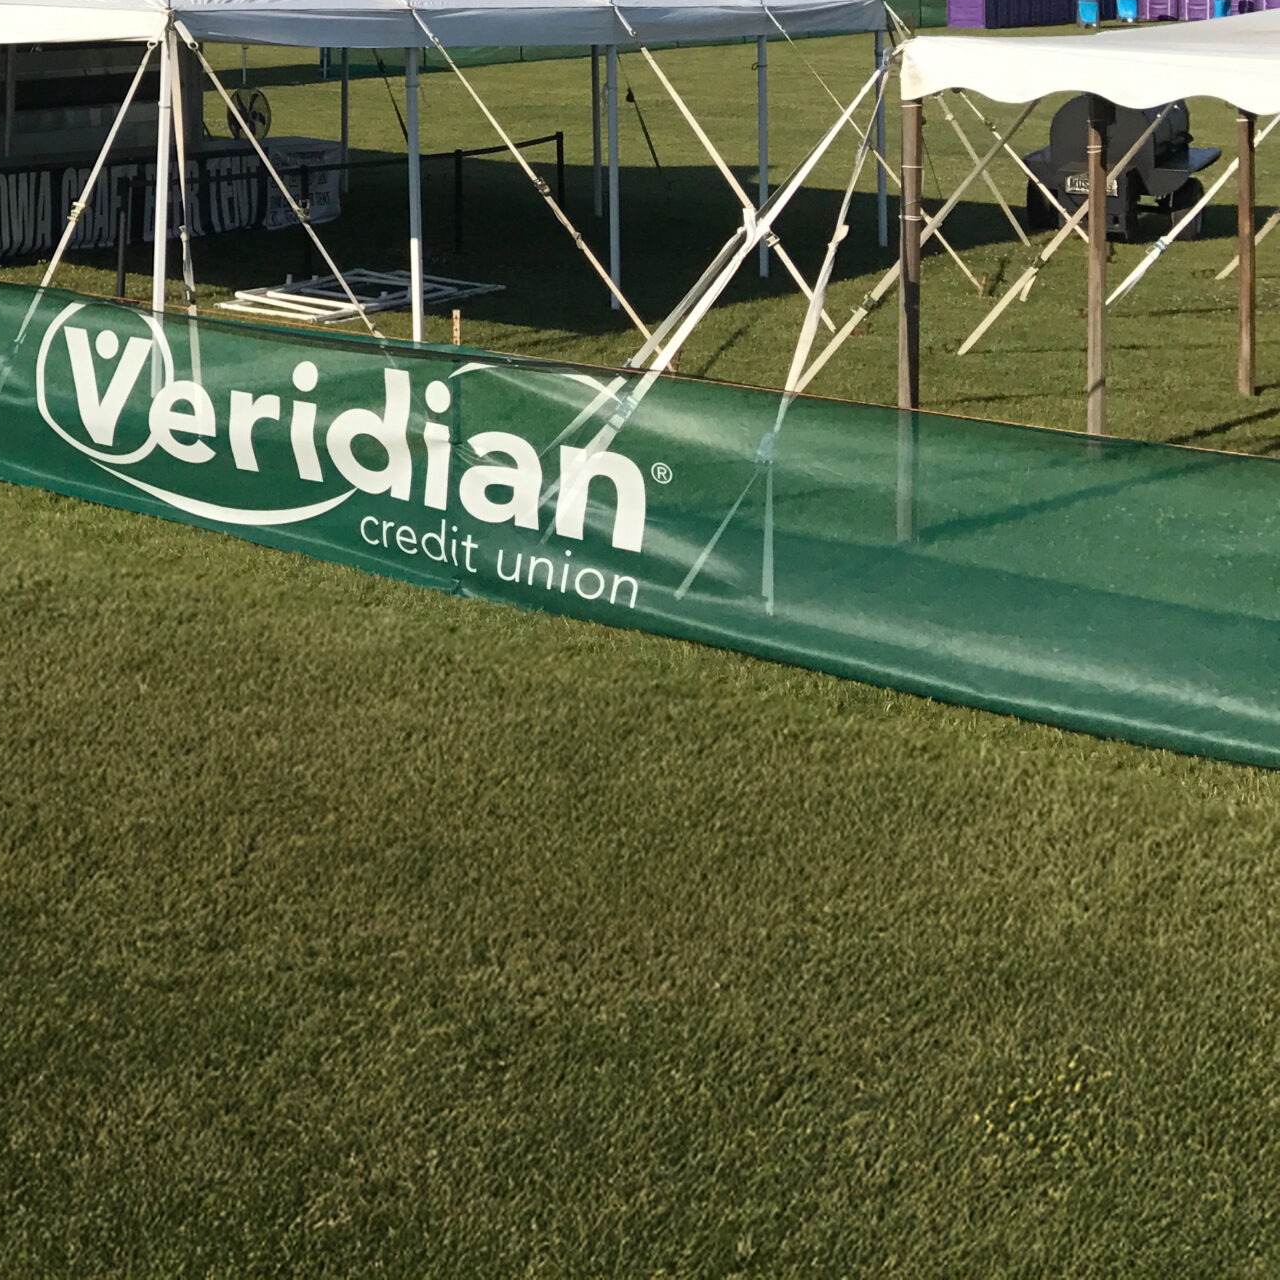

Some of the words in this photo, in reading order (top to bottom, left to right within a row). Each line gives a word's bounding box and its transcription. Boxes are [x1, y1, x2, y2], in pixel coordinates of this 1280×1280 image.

[63, 326, 647, 553] Veridian
[360, 515, 478, 573] credit
[497, 549, 639, 609] union
